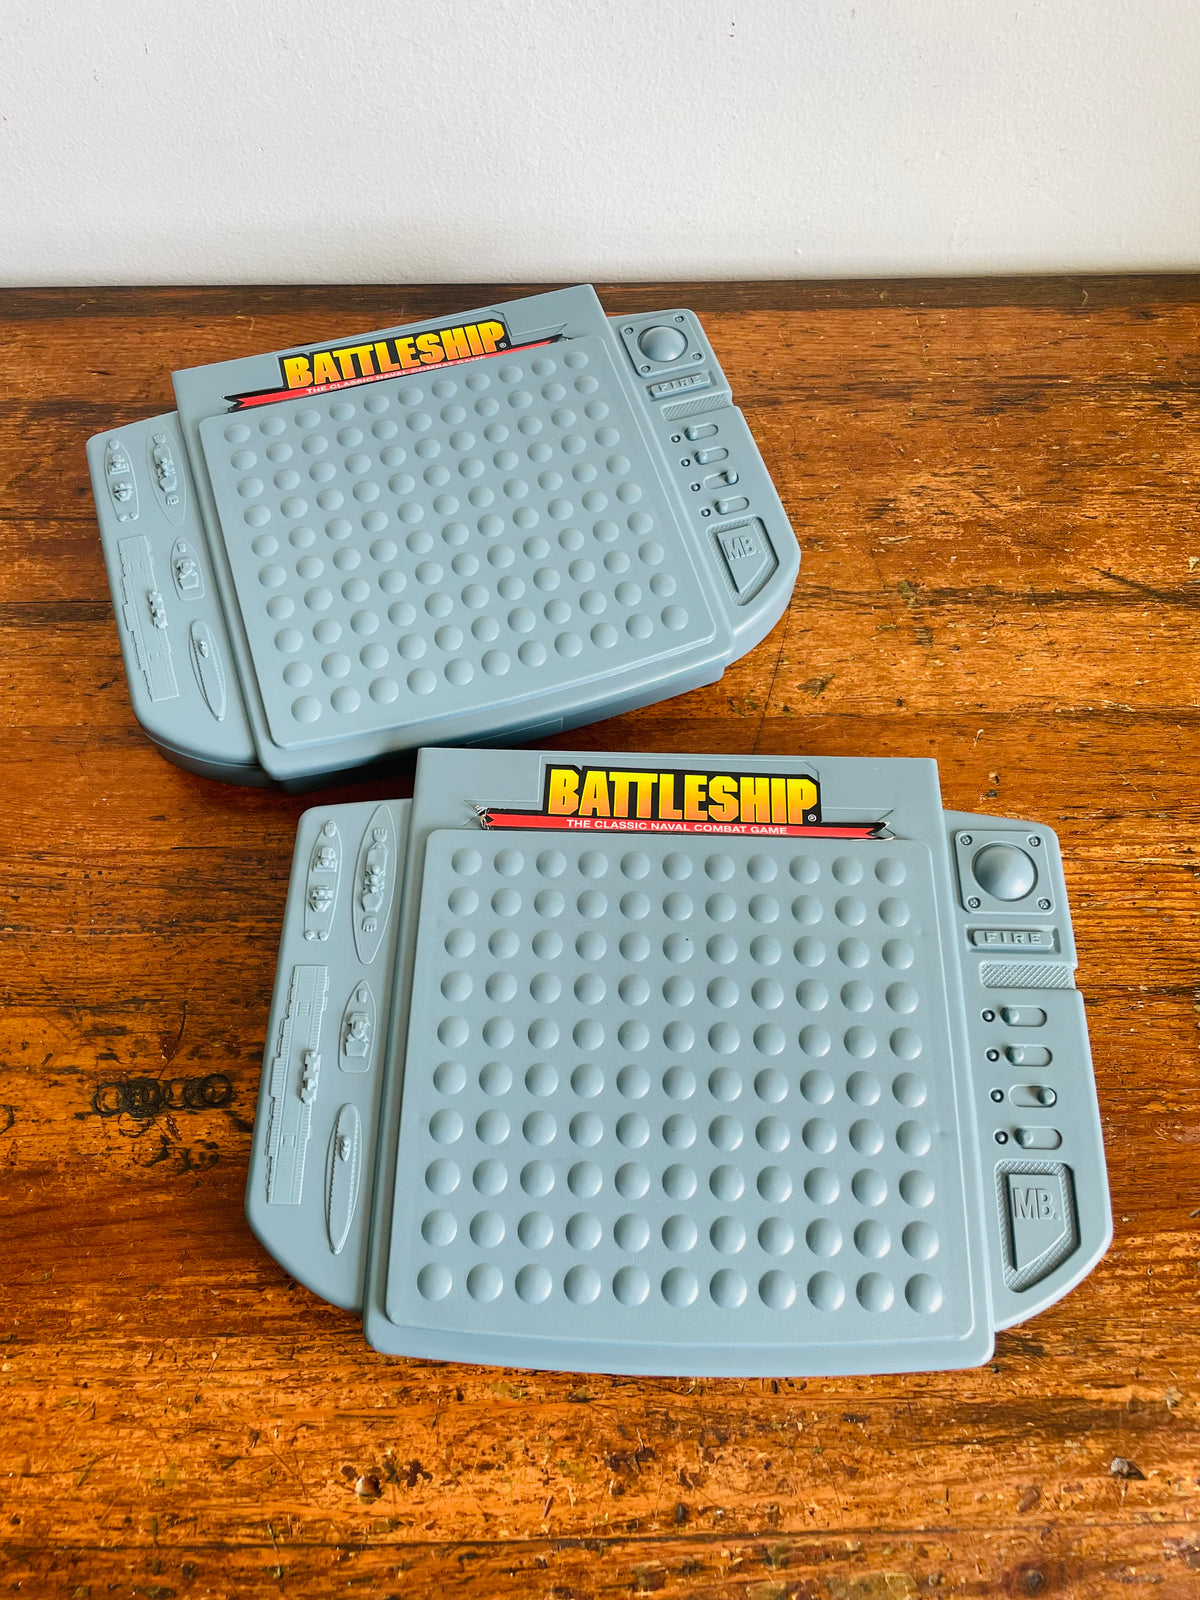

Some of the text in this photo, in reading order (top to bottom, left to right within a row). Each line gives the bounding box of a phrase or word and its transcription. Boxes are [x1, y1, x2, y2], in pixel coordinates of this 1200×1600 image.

[284, 321, 505, 389] BATTLESHIP
[306, 386, 327, 394] THE
[329, 377, 373, 389] CLASSIC
[376, 371, 406, 380] NAVAL
[658, 375, 702, 391] FIRE
[548, 769, 818, 824] BATTLESHIP
[566, 819, 788, 835] THE CLASSIC NAVAL COMBAT GAME
[984, 931, 1041, 943] FIRE
